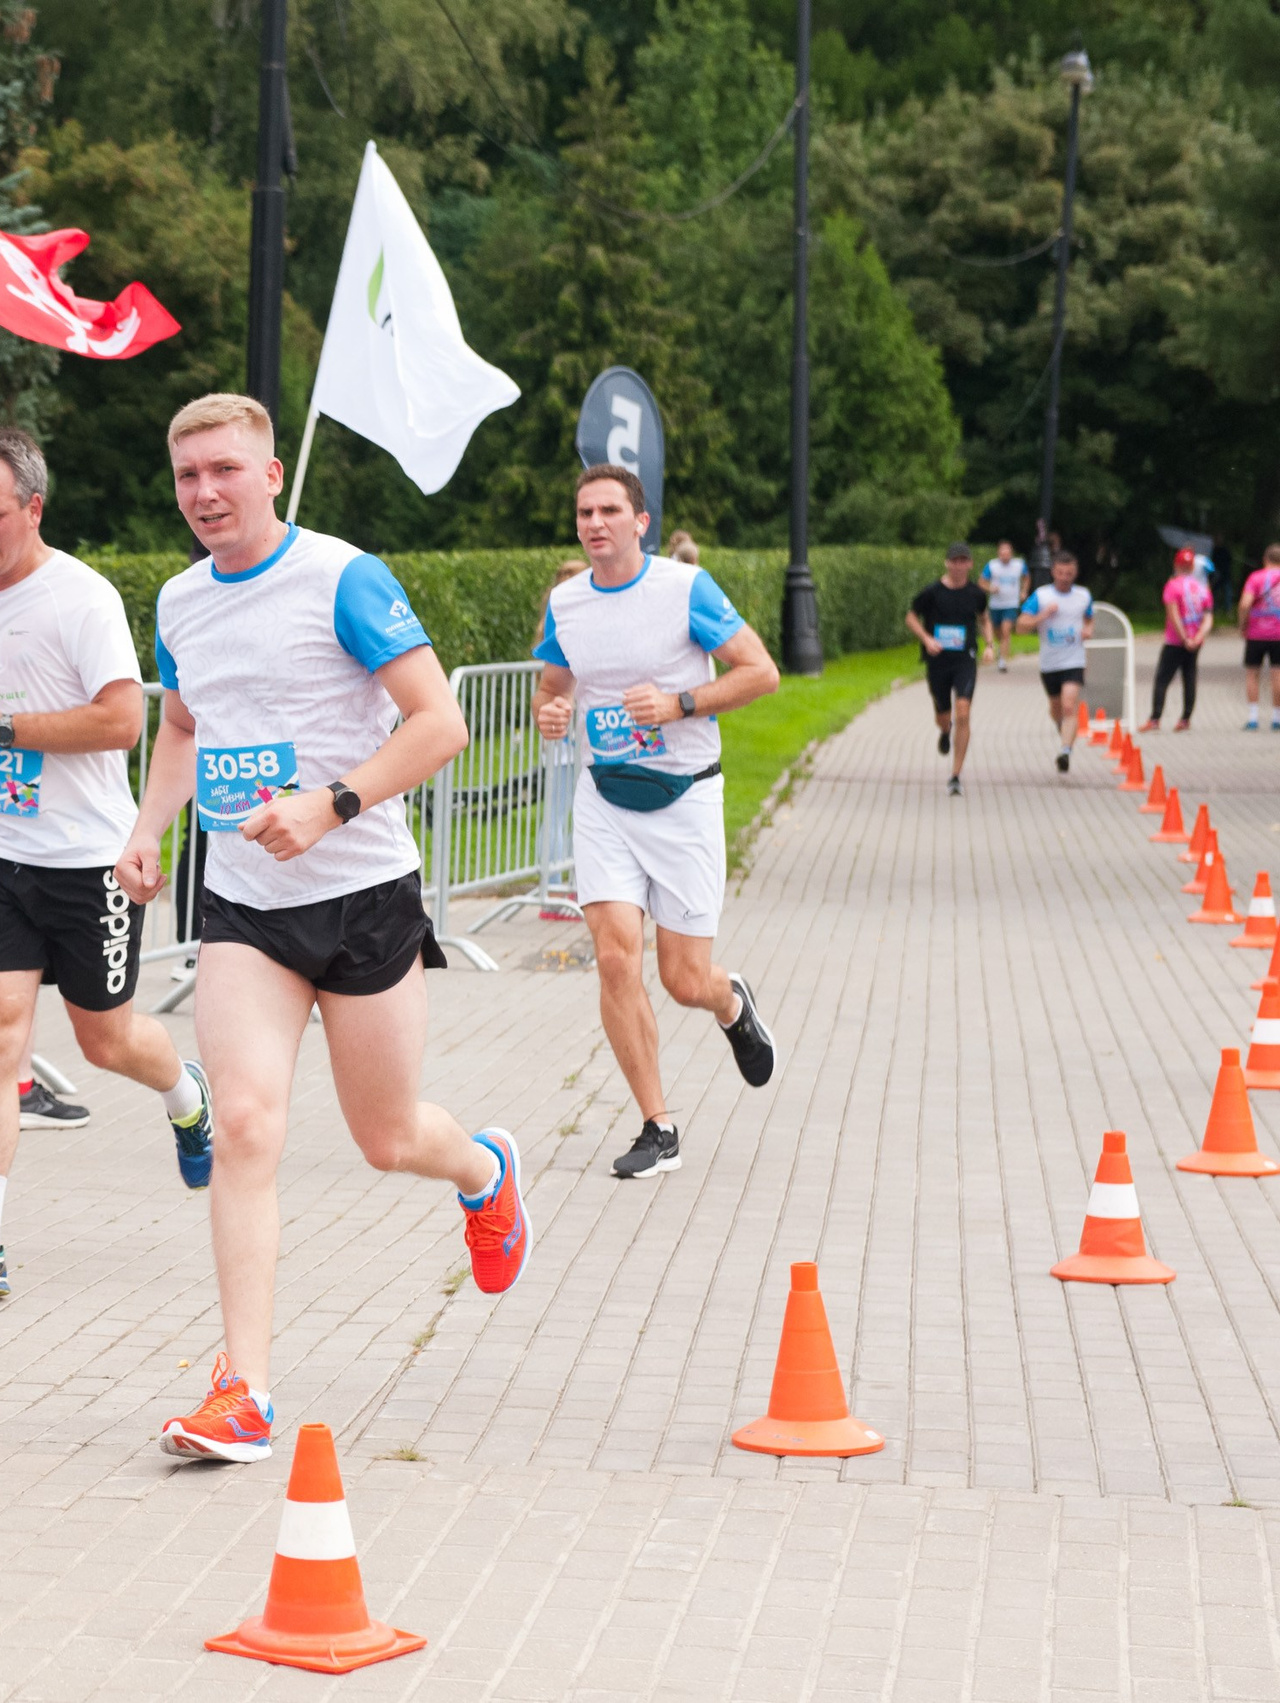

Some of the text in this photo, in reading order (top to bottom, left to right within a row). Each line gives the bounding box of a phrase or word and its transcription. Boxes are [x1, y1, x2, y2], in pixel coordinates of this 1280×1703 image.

[594, 709, 637, 730] 302
[204, 750, 280, 780] 3058
[100, 869, 130, 994] adidas
